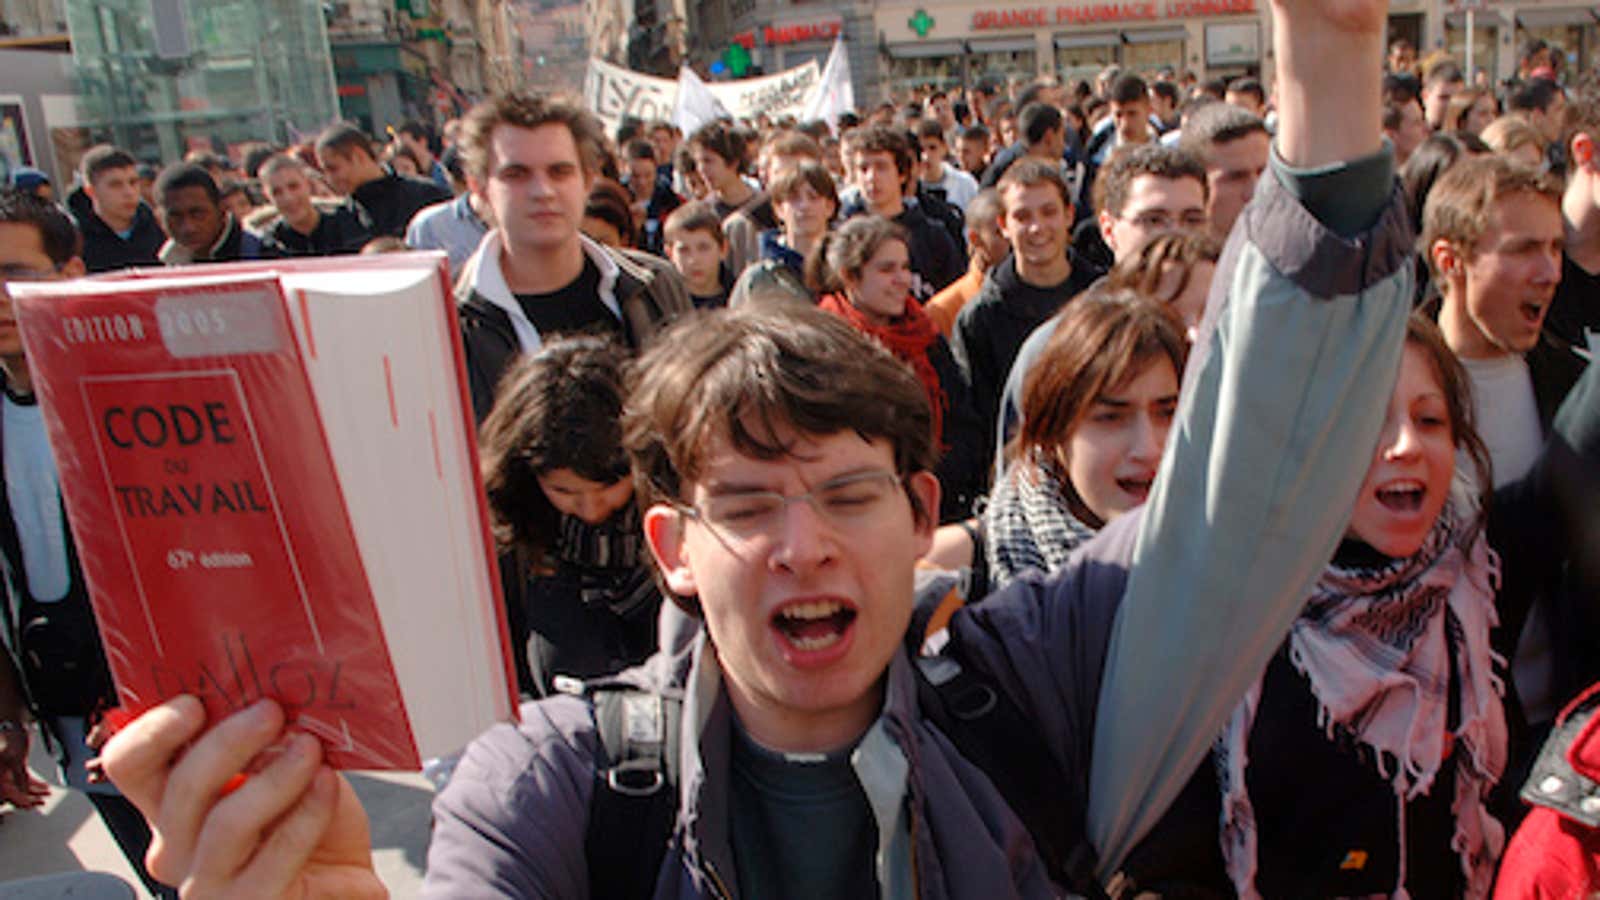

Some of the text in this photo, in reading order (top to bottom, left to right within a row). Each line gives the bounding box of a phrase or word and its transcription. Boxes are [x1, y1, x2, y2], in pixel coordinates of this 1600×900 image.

[972, 6, 1048, 30] GRANDE
[1055, 1, 1157, 26] PHARMACIE
[62, 309, 228, 343] EDITION 2005
[104, 401, 236, 449] CODE
[165, 458, 189, 474] DU
[117, 482, 268, 518] TRAVAIL
